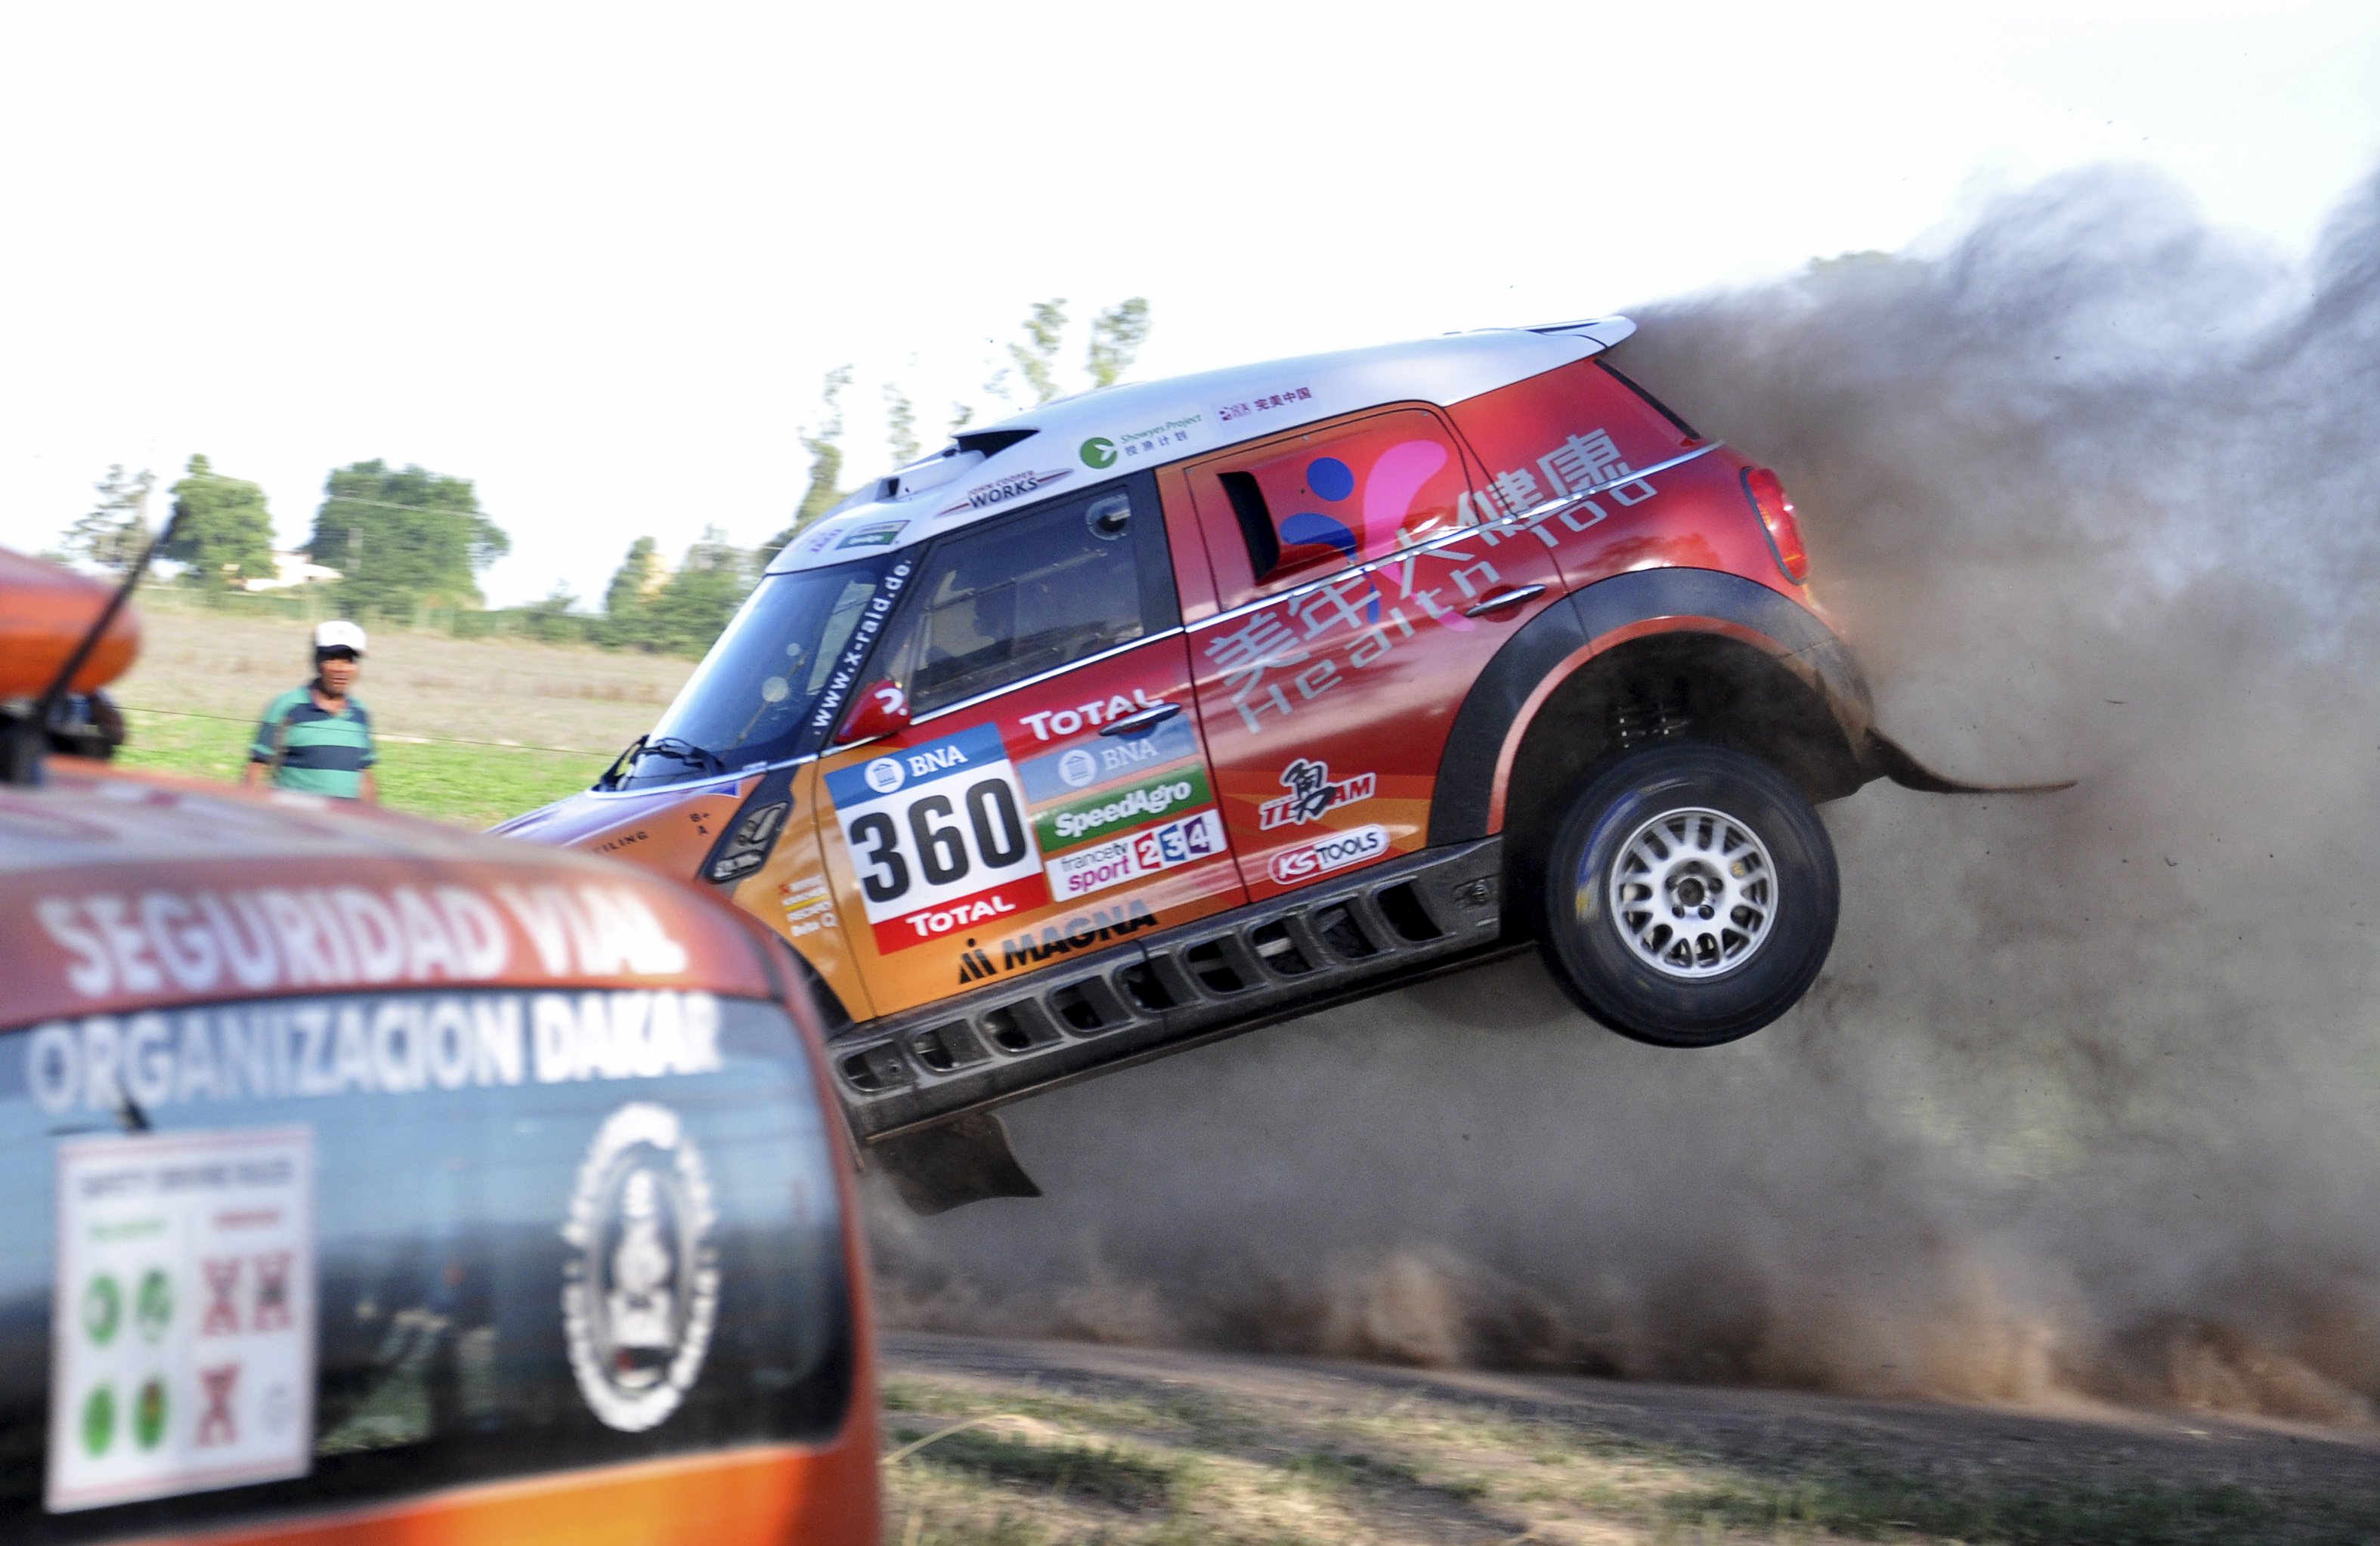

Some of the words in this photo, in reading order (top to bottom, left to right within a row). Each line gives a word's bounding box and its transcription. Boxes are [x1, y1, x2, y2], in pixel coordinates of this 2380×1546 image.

[1255, 387, 1312, 412] 完美中国
[970, 477, 1038, 509] WORKS
[1205, 428, 1629, 701] 美年大健康
[1233, 561, 1499, 734] Health
[1021, 688, 1165, 742] TOTAL
[910, 744, 968, 778] BNA
[1100, 738, 1159, 771] BNA
[1055, 780, 1192, 839] SpeedAgro
[850, 778, 1027, 903] 360
[1069, 855, 1130, 892] sport
[36, 883, 509, 997] SEGURIDAD
[499, 883, 686, 977] VIAL
[905, 895, 1017, 937] TOTAL
[1004, 899, 1158, 969] MAGNA
[28, 994, 526, 1113] ORGANIZACION
[534, 990, 720, 1084] DAKAR
